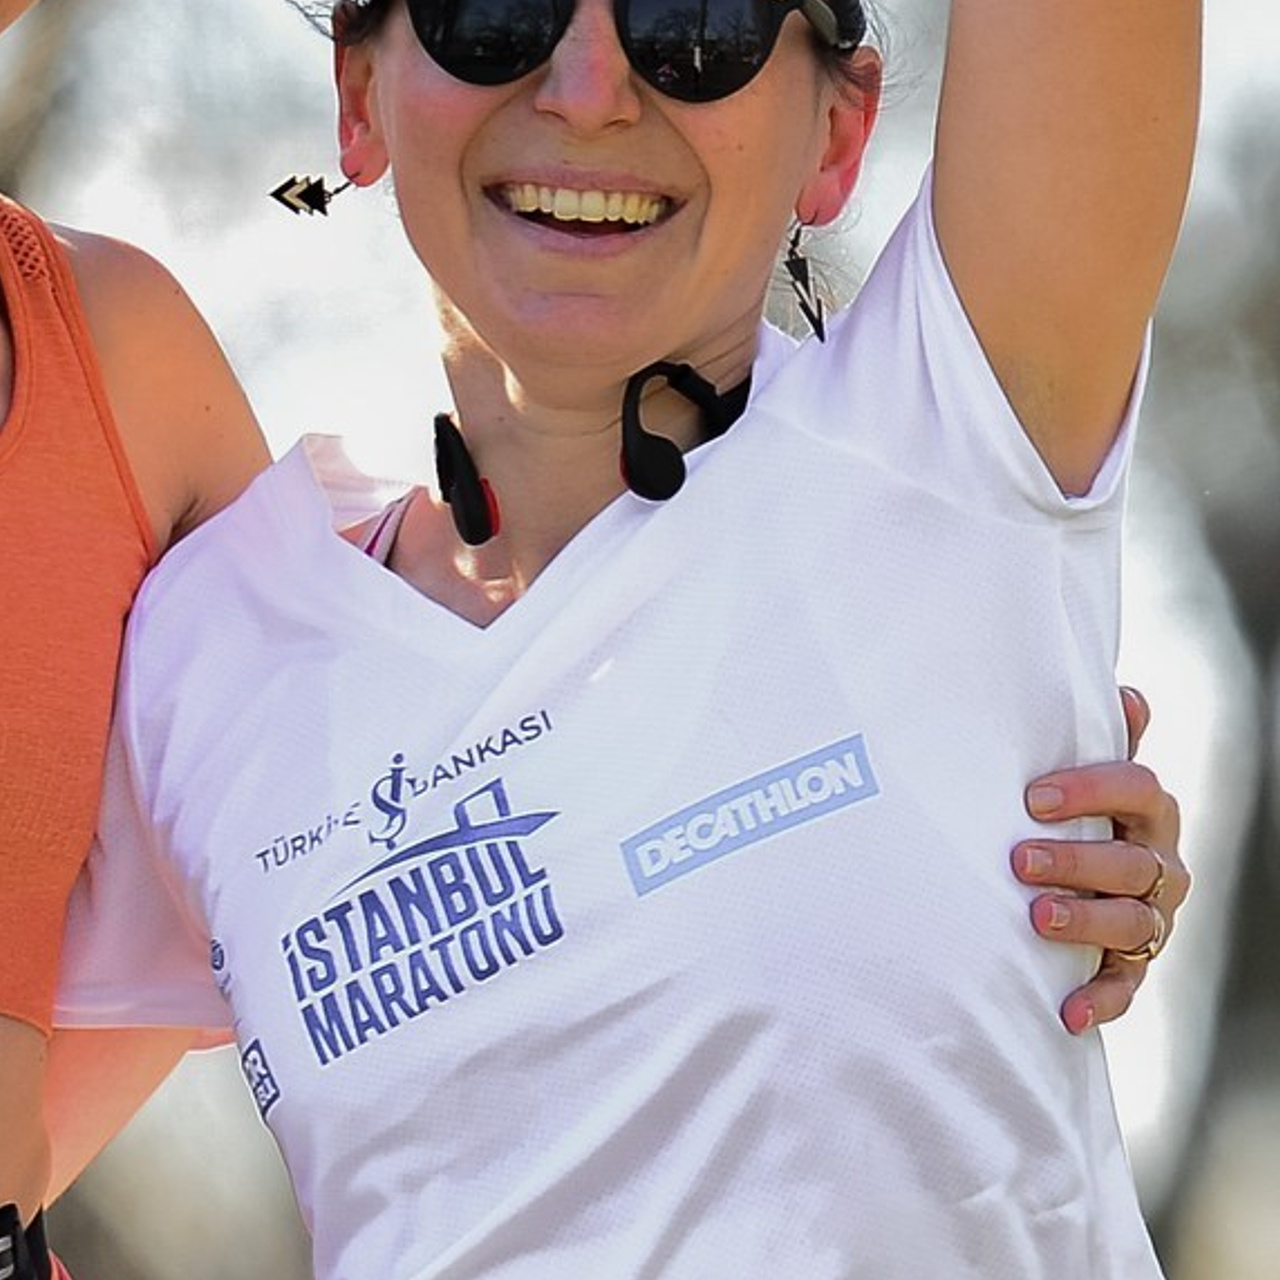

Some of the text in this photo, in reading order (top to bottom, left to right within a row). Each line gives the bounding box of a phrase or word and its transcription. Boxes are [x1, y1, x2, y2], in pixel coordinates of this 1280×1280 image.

[255, 801, 361, 872] TÜRKİE
[635, 751, 864, 878] DECATHLON
[281, 840, 548, 1002] İSTANBUL
[301, 884, 564, 1066] MARATONU
